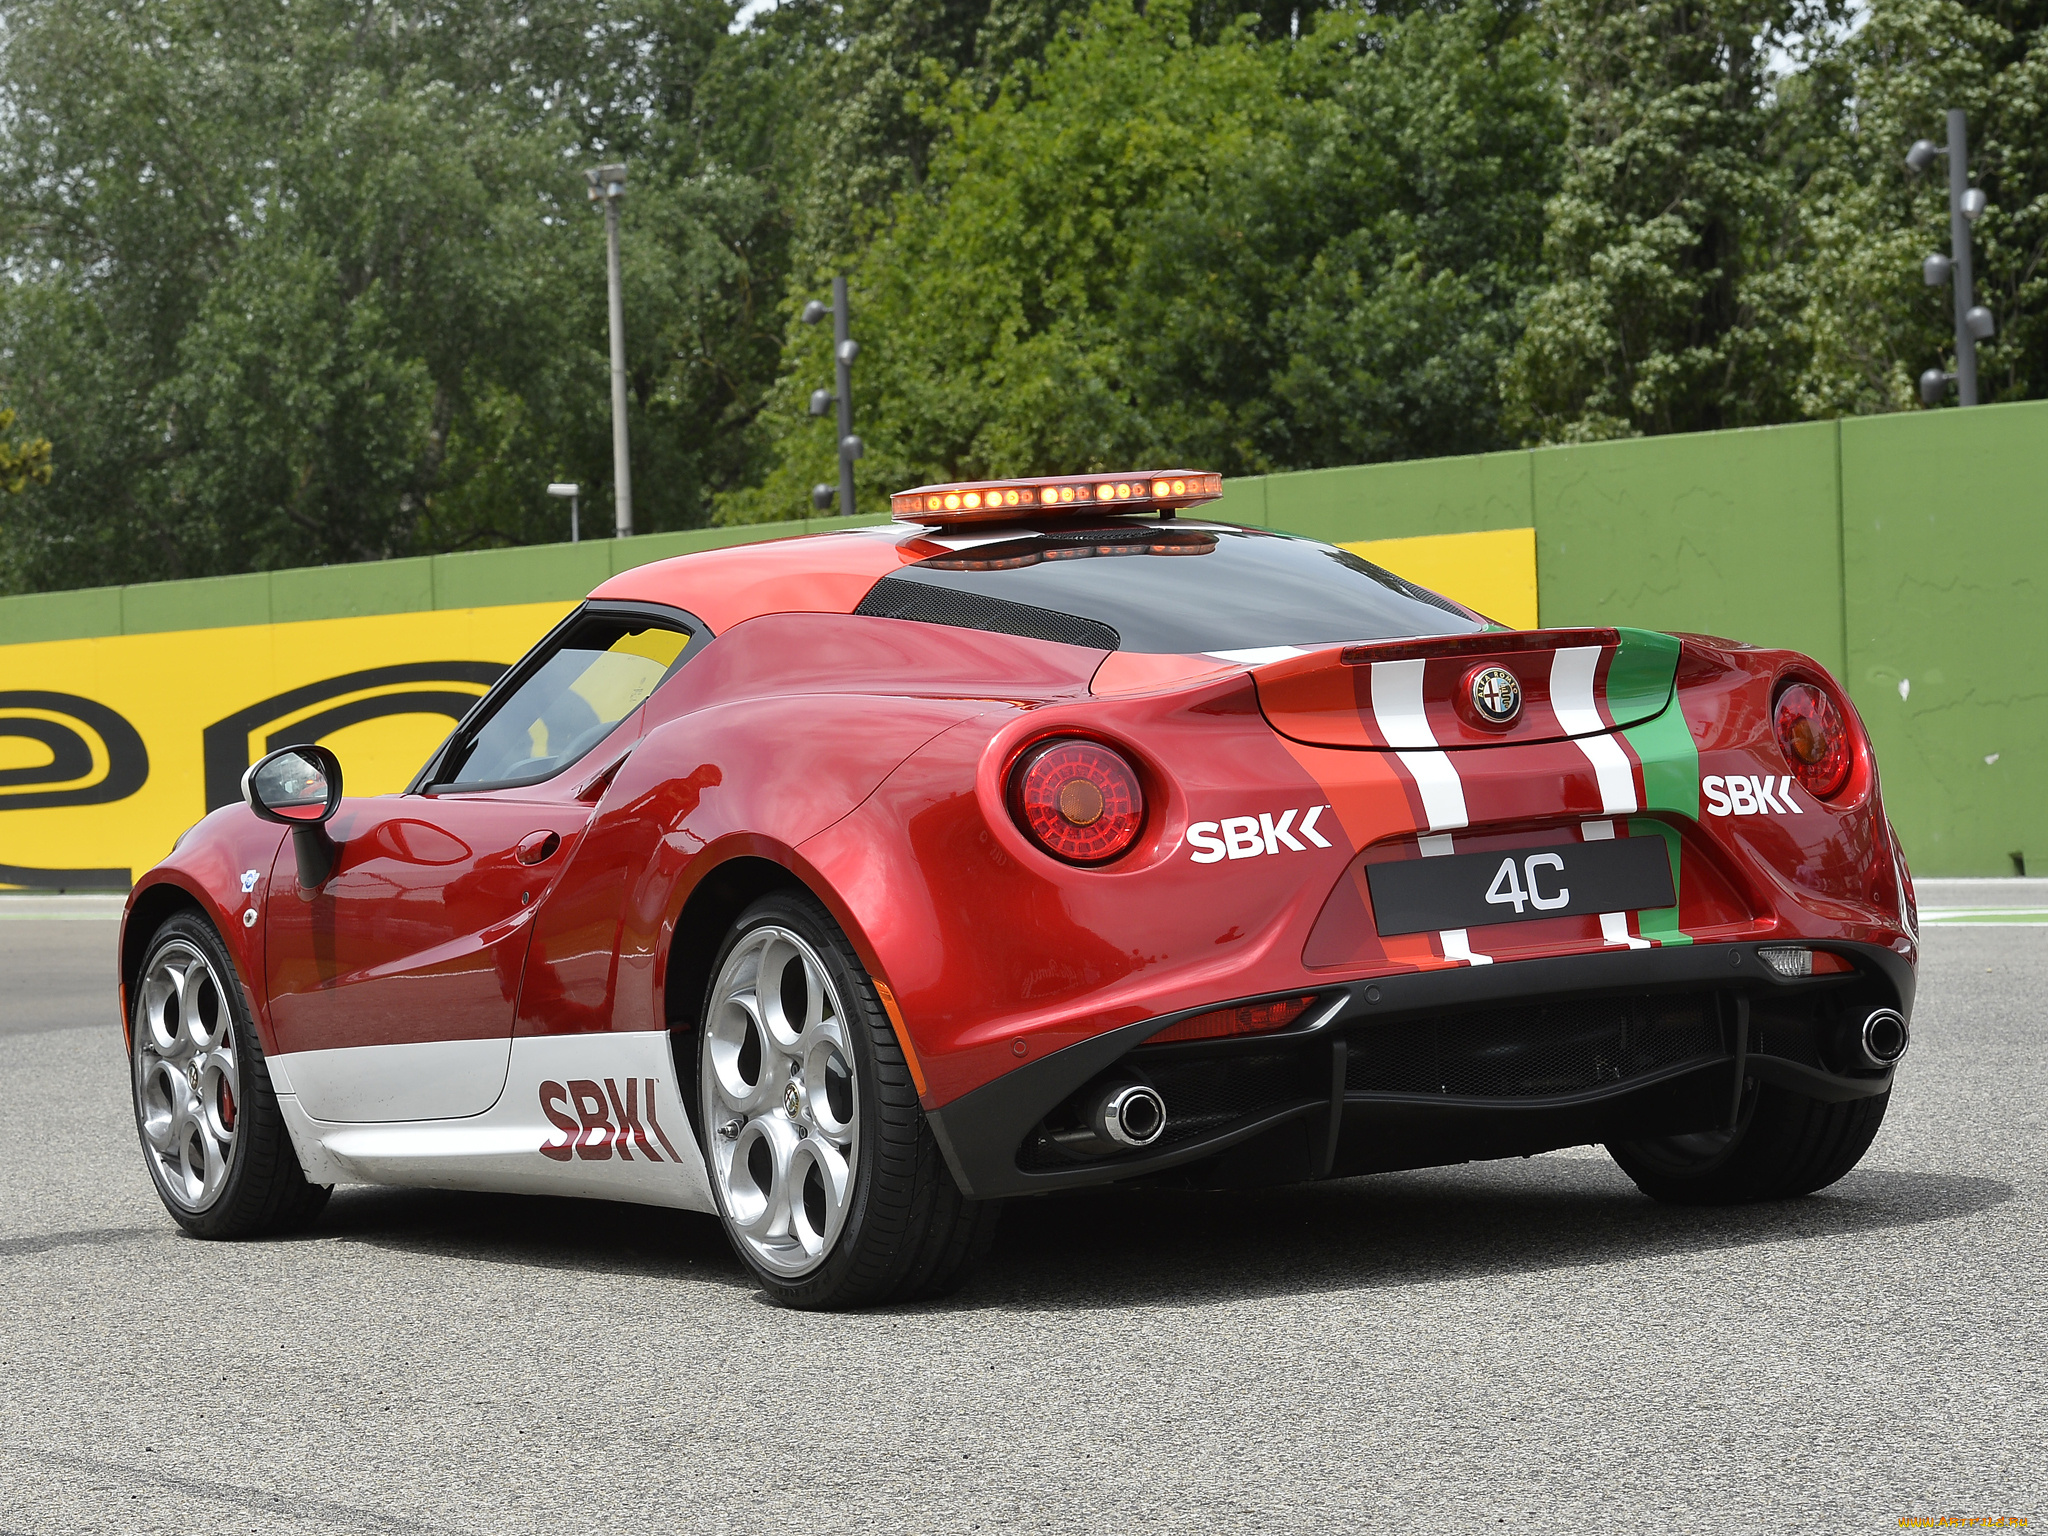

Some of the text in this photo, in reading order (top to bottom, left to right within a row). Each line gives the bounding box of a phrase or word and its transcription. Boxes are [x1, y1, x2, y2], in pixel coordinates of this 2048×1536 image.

[1477, 671, 1519, 698] ALFA ROMEO
[1485, 852, 1570, 914] 4C
